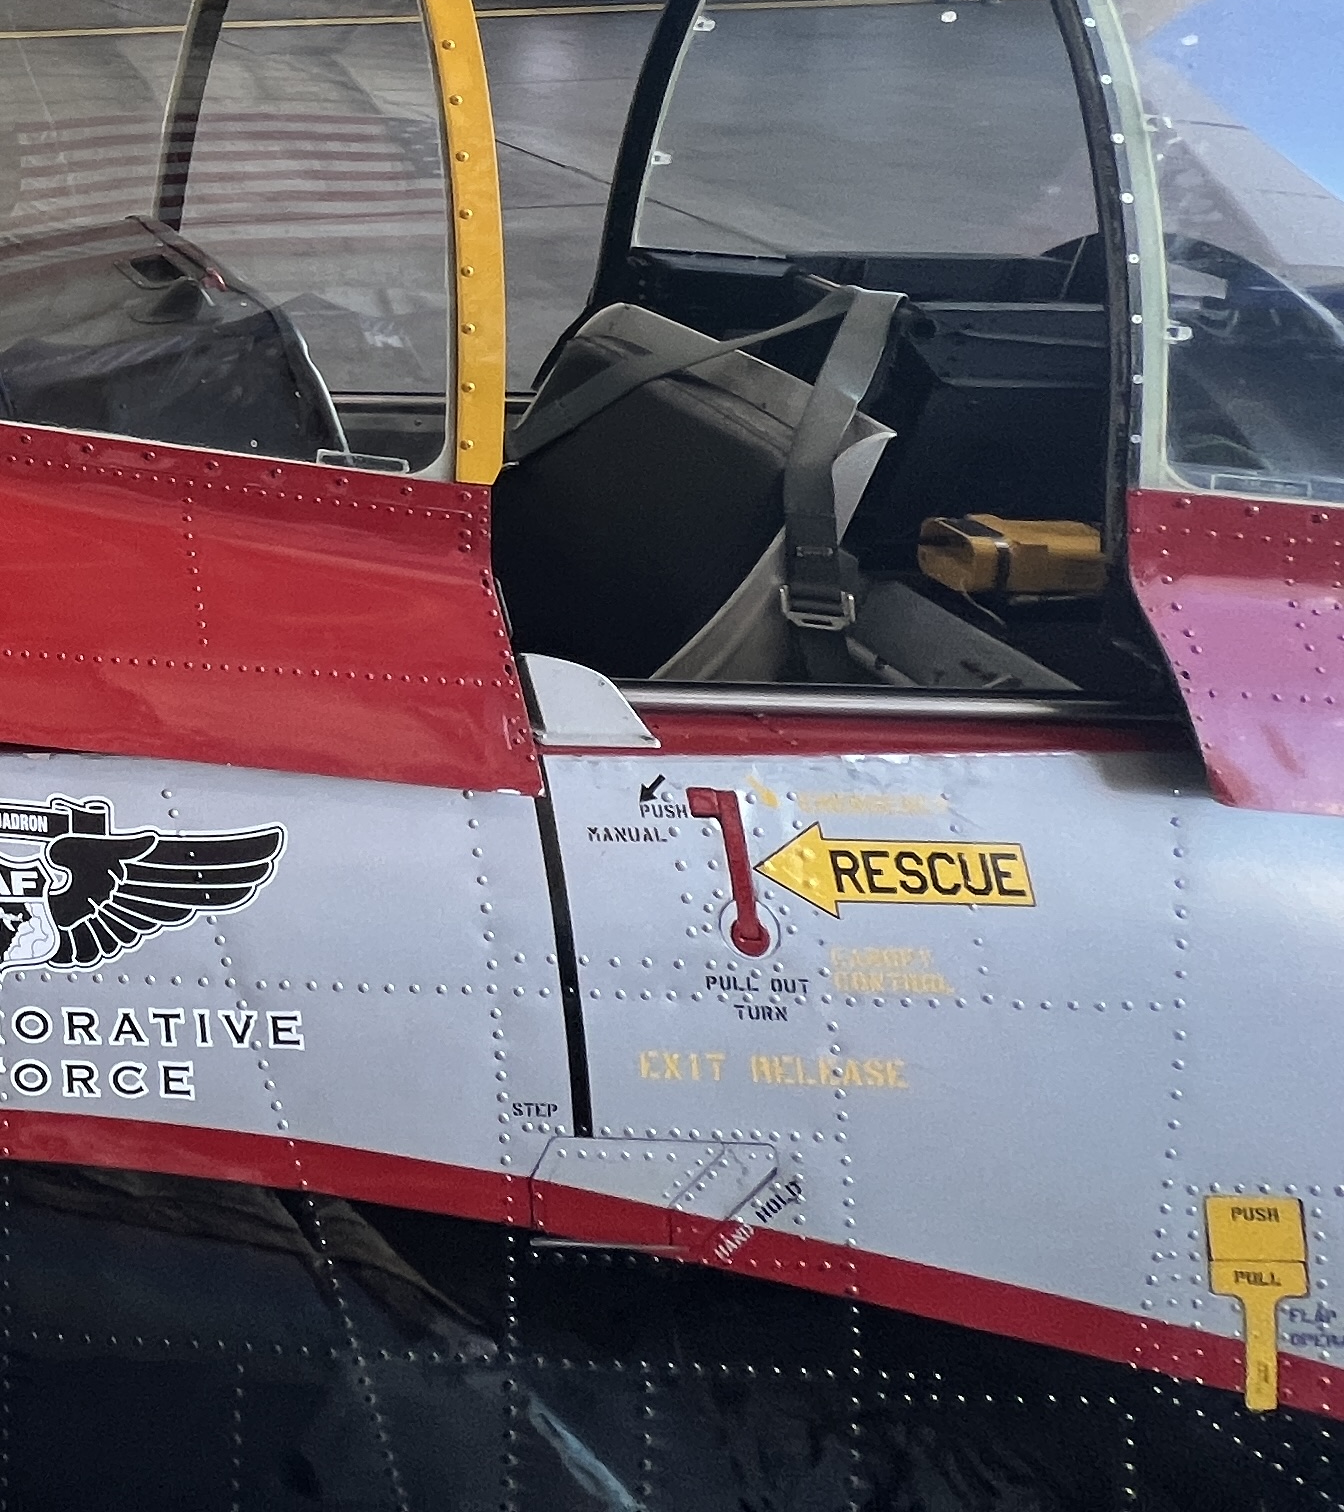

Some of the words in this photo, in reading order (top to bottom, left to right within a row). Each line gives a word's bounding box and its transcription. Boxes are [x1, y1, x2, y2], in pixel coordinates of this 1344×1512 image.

[639, 803, 688, 819] PUSH
[587, 826, 668, 843] MANUAL
[829, 850, 1026, 897] RESCUE
[706, 975, 758, 993] PULL
[771, 978, 809, 994] OUT
[736, 1004, 788, 1022] TURN
[639, 1050, 726, 1082] EXIT
[750, 1054, 908, 1089] RELEASE
[512, 1102, 558, 1117] STEP
[755, 1180, 803, 1224] HOLD
[1231, 1206, 1280, 1223] PUSH
[1233, 1270, 1282, 1287] PULL
